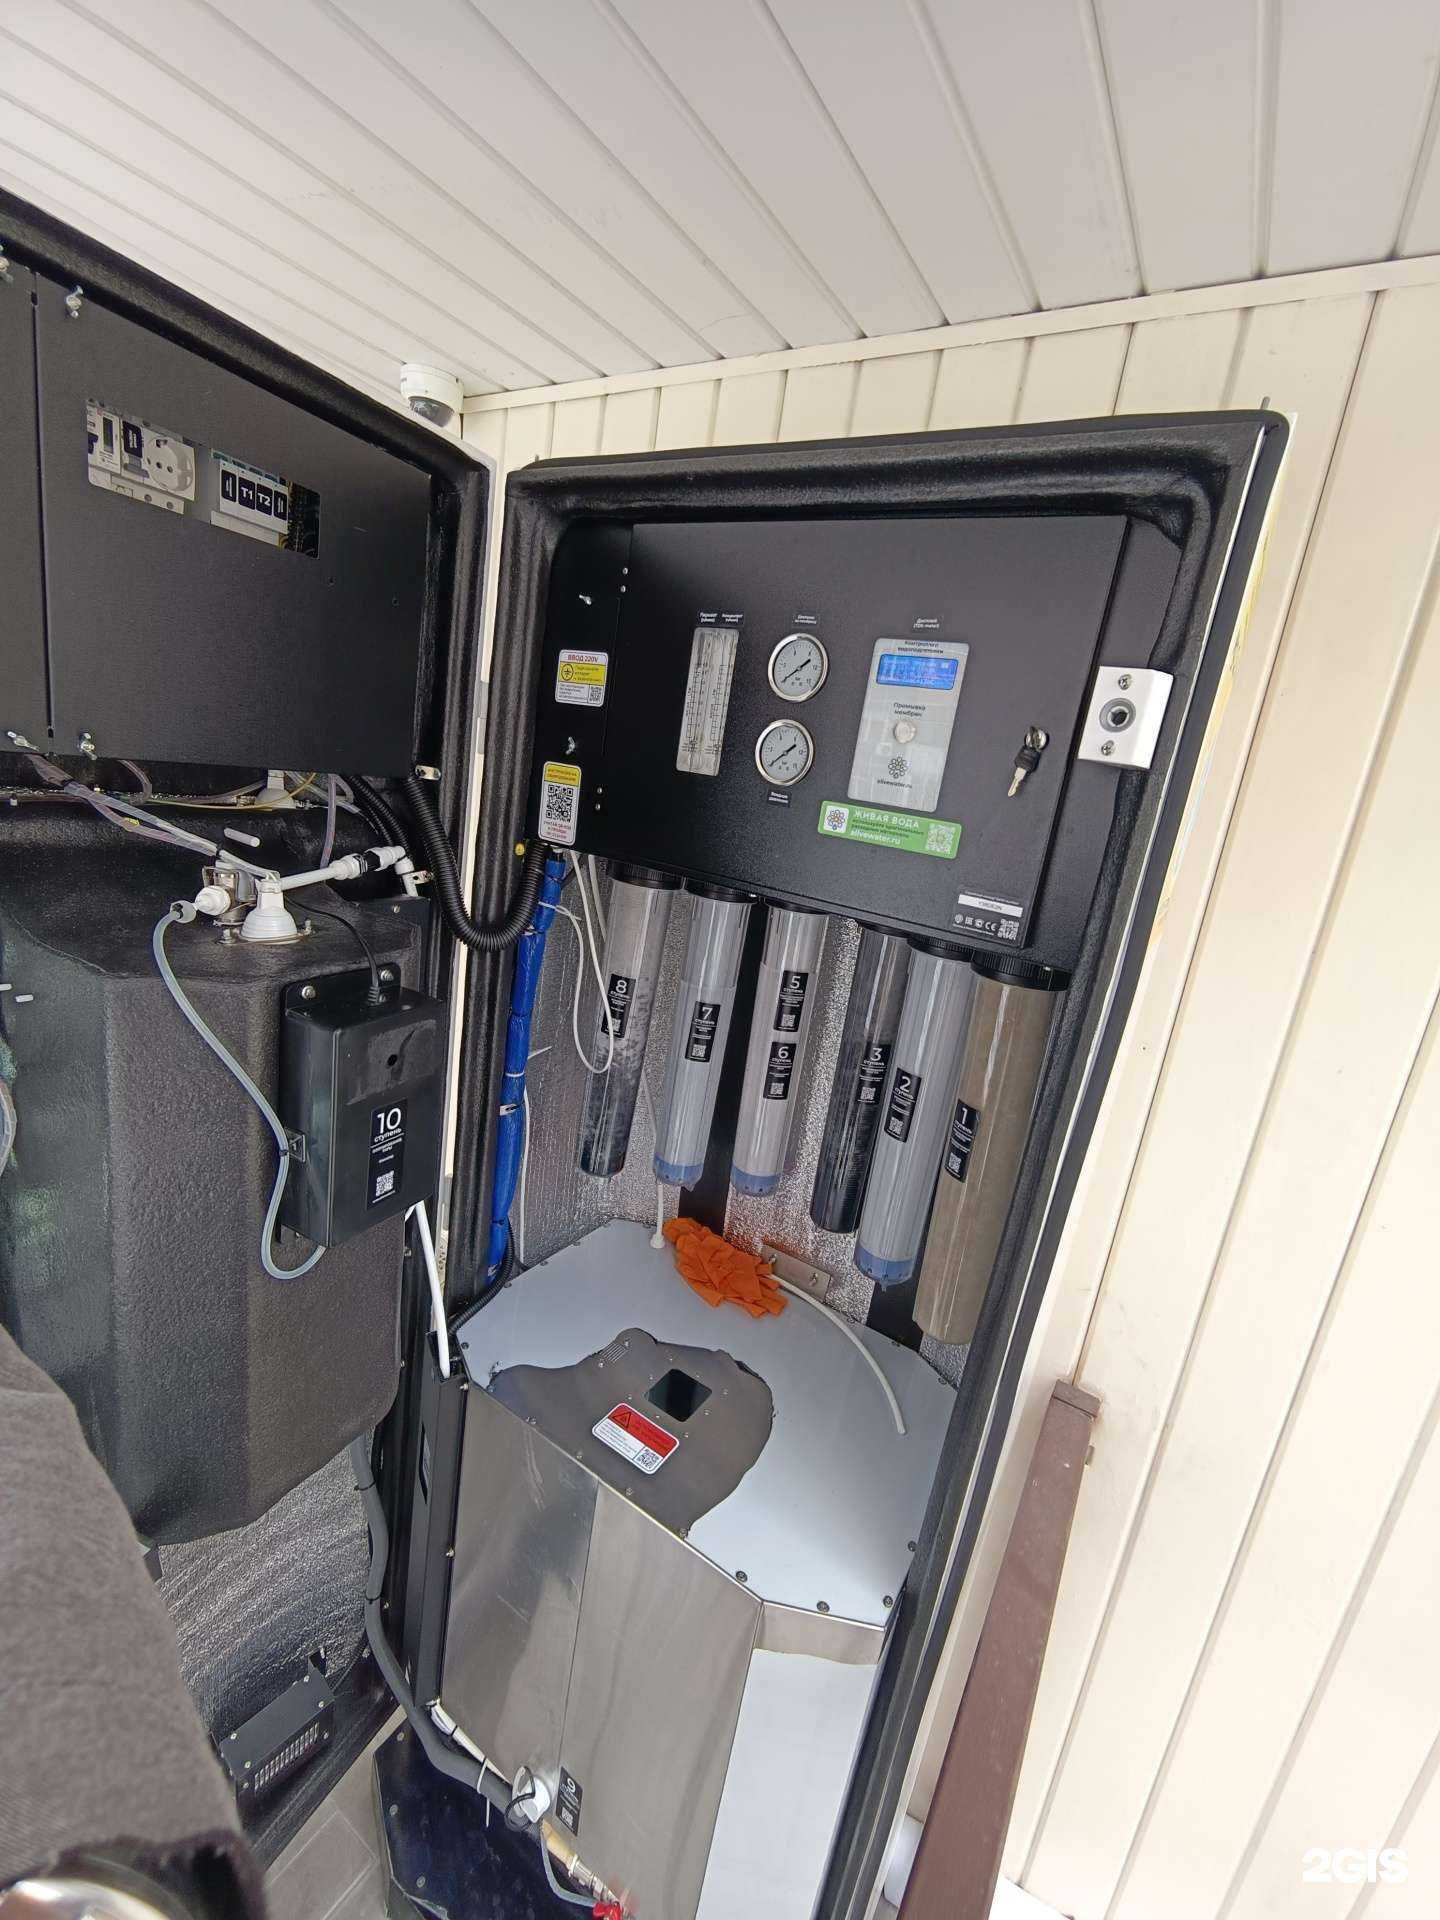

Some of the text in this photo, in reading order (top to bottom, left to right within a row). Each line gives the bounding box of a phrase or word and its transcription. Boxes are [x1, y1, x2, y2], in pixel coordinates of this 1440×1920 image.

[241, 486, 253, 500] T1
[257, 493, 271, 506] T2
[893, 702, 926, 711] Промывка
[877, 779, 913, 789] alivewater.ru
[854, 810, 920, 828] ЖИВАЯ ВОДА
[850, 829, 901, 845] alivewater.ru
[615, 979, 627, 994] 8
[789, 975, 801, 989] 5
[701, 1006, 713, 1020] 7
[777, 1046, 789, 1059] 6
[870, 1047, 883, 1061] 3
[863, 1059, 885, 1067] ступень
[899, 1076, 911, 1093] 2
[377, 1107, 402, 1134] 10
[962, 1107, 969, 1125] 1
[374, 1127, 402, 1143] ступень
[567, 1777, 576, 1793] 9
